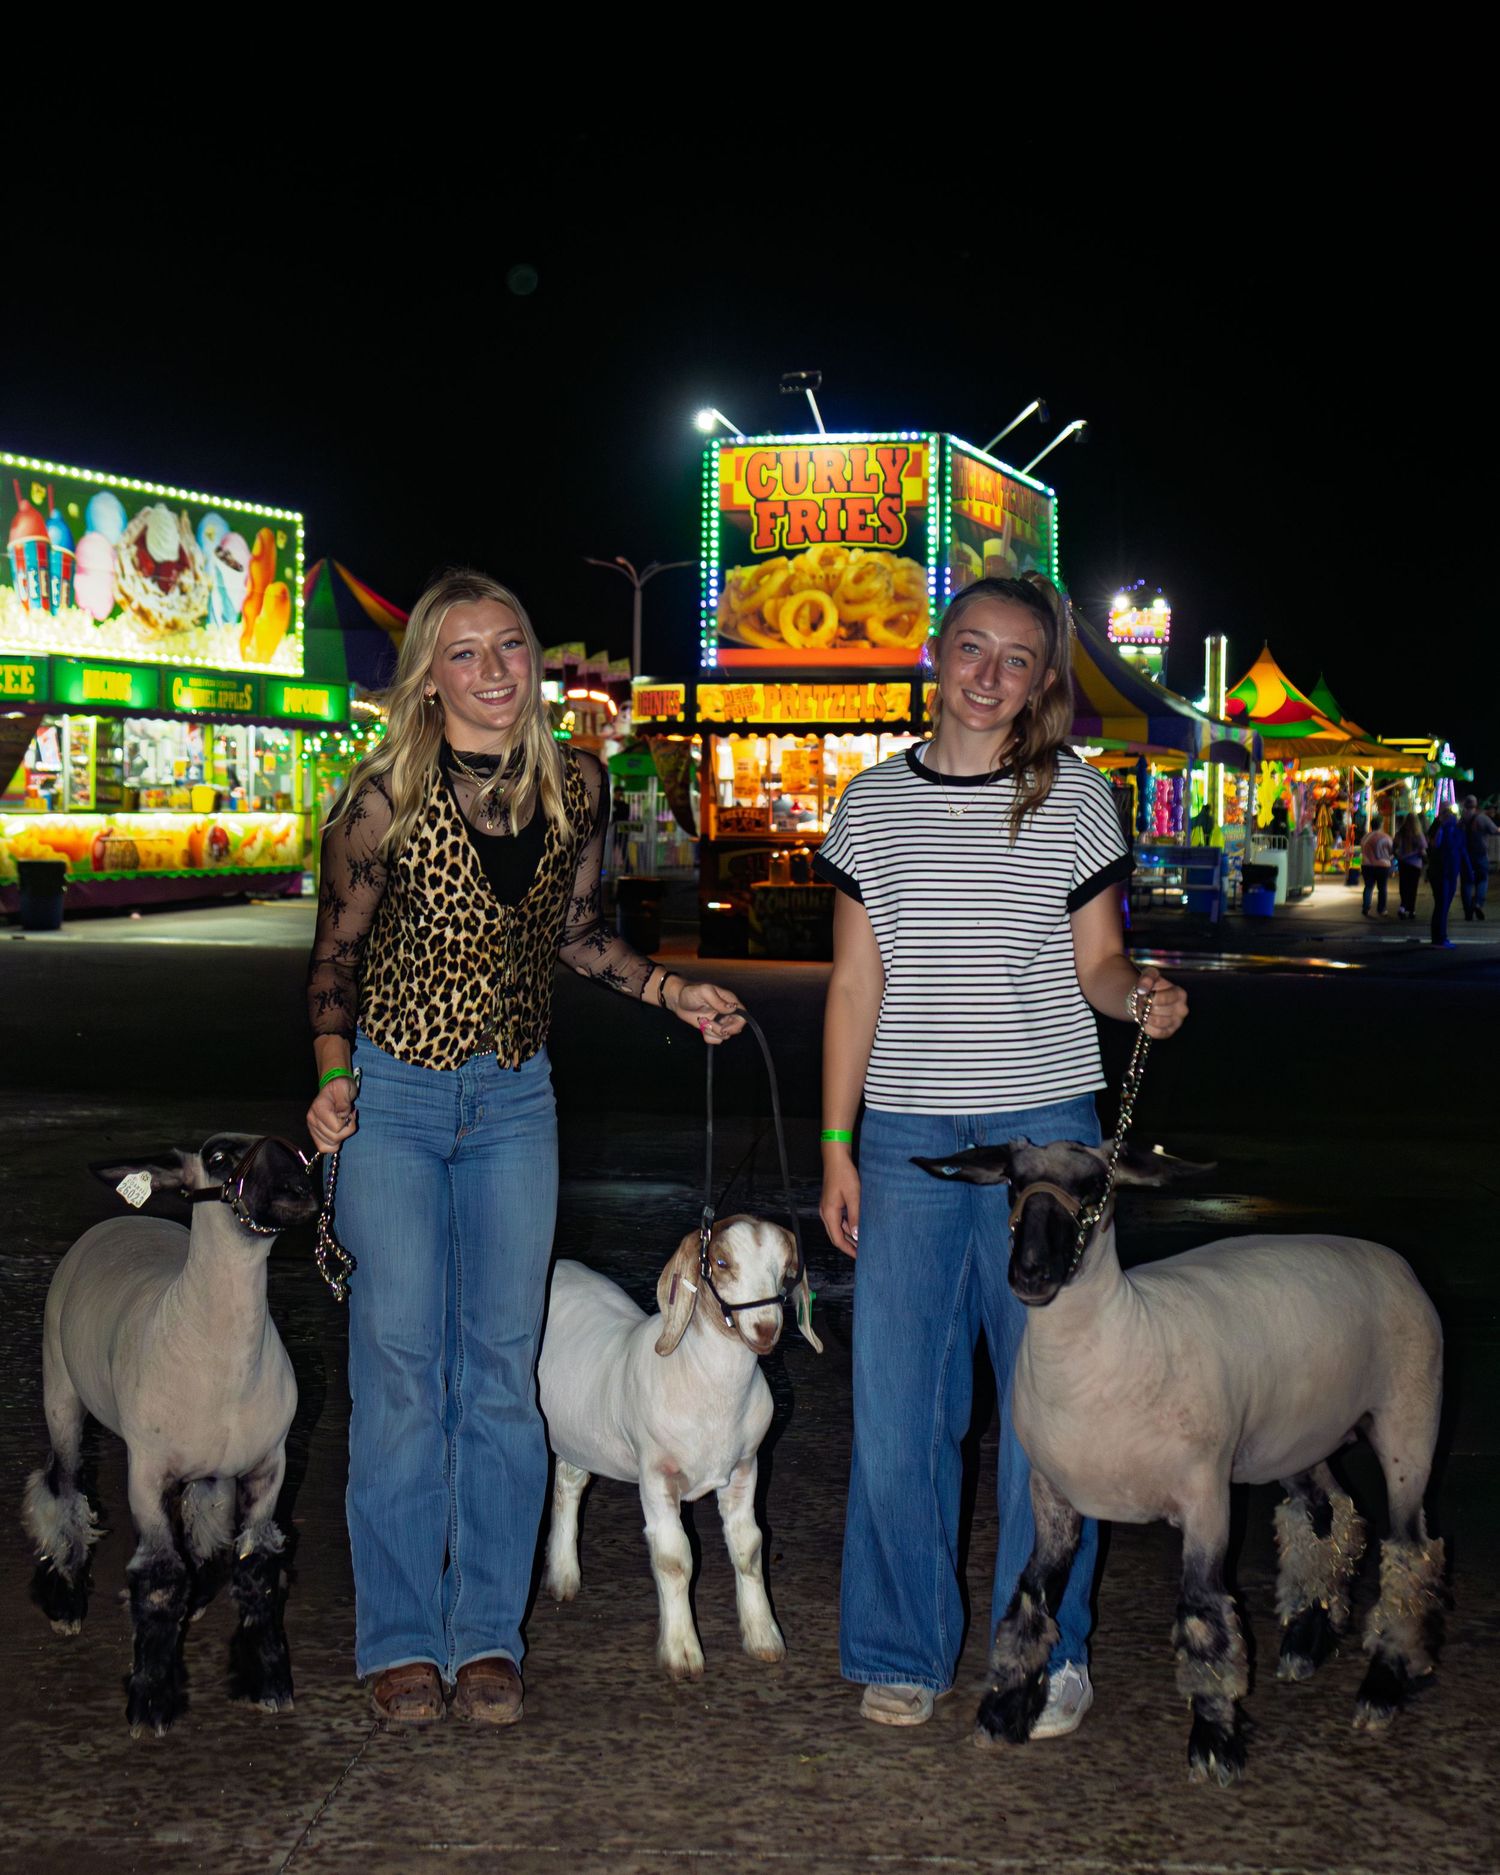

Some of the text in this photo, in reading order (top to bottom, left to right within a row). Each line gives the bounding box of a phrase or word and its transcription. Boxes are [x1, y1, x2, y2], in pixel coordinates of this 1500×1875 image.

[745, 447, 909, 499] CURLY
[754, 496, 904, 548] FRIES
[724, 686, 754, 704] DEEP
[763, 684, 887, 719] PRETZELS
